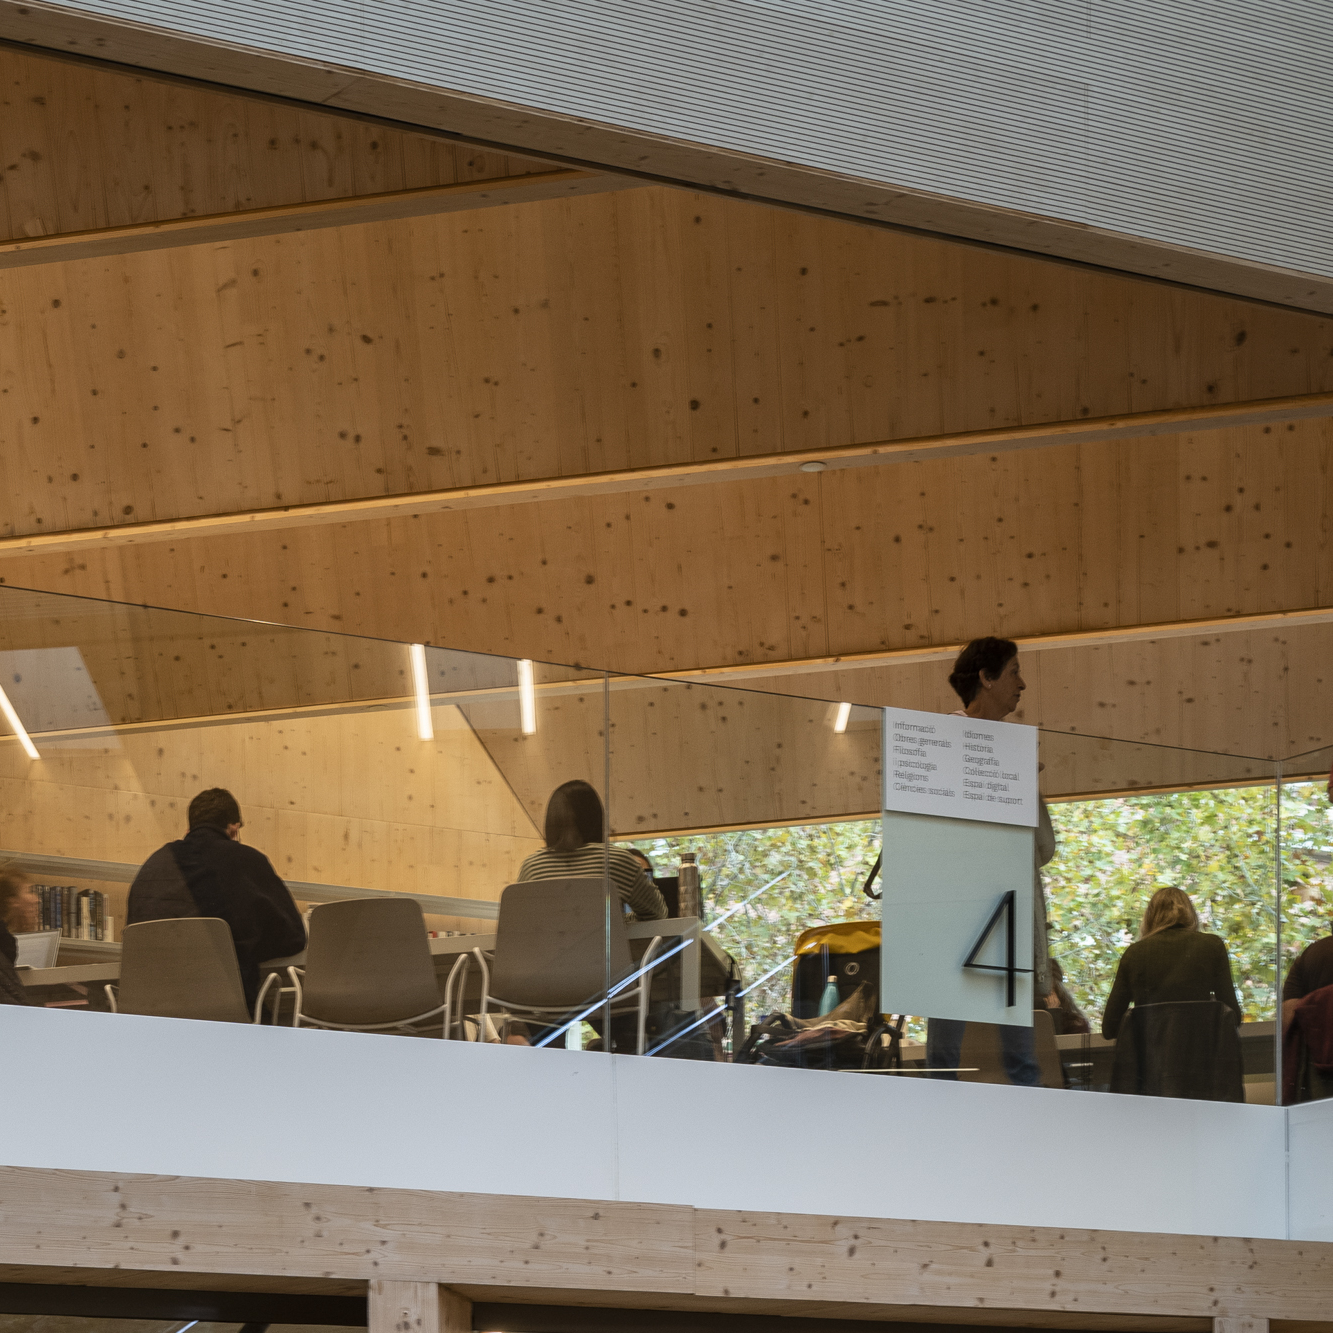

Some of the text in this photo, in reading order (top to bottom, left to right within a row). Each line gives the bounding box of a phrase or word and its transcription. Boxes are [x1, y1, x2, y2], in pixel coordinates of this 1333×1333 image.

[893, 721, 936, 734] Informació
[893, 734, 952, 748] Obres generals
[963, 730, 995, 742] Idiomes
[893, 746, 927, 758] Filosofia
[898, 759, 938, 772] psicologia
[963, 755, 1000, 767] Geografia
[893, 770, 929, 782] Religions
[1001, 771, 1021, 782] local
[963, 779, 1010, 793] Espai digital
[928, 787, 956, 798] socials
[963, 791, 984, 802] Espai
[986, 793, 997, 803] de
[962, 890, 1034, 1008] 4
